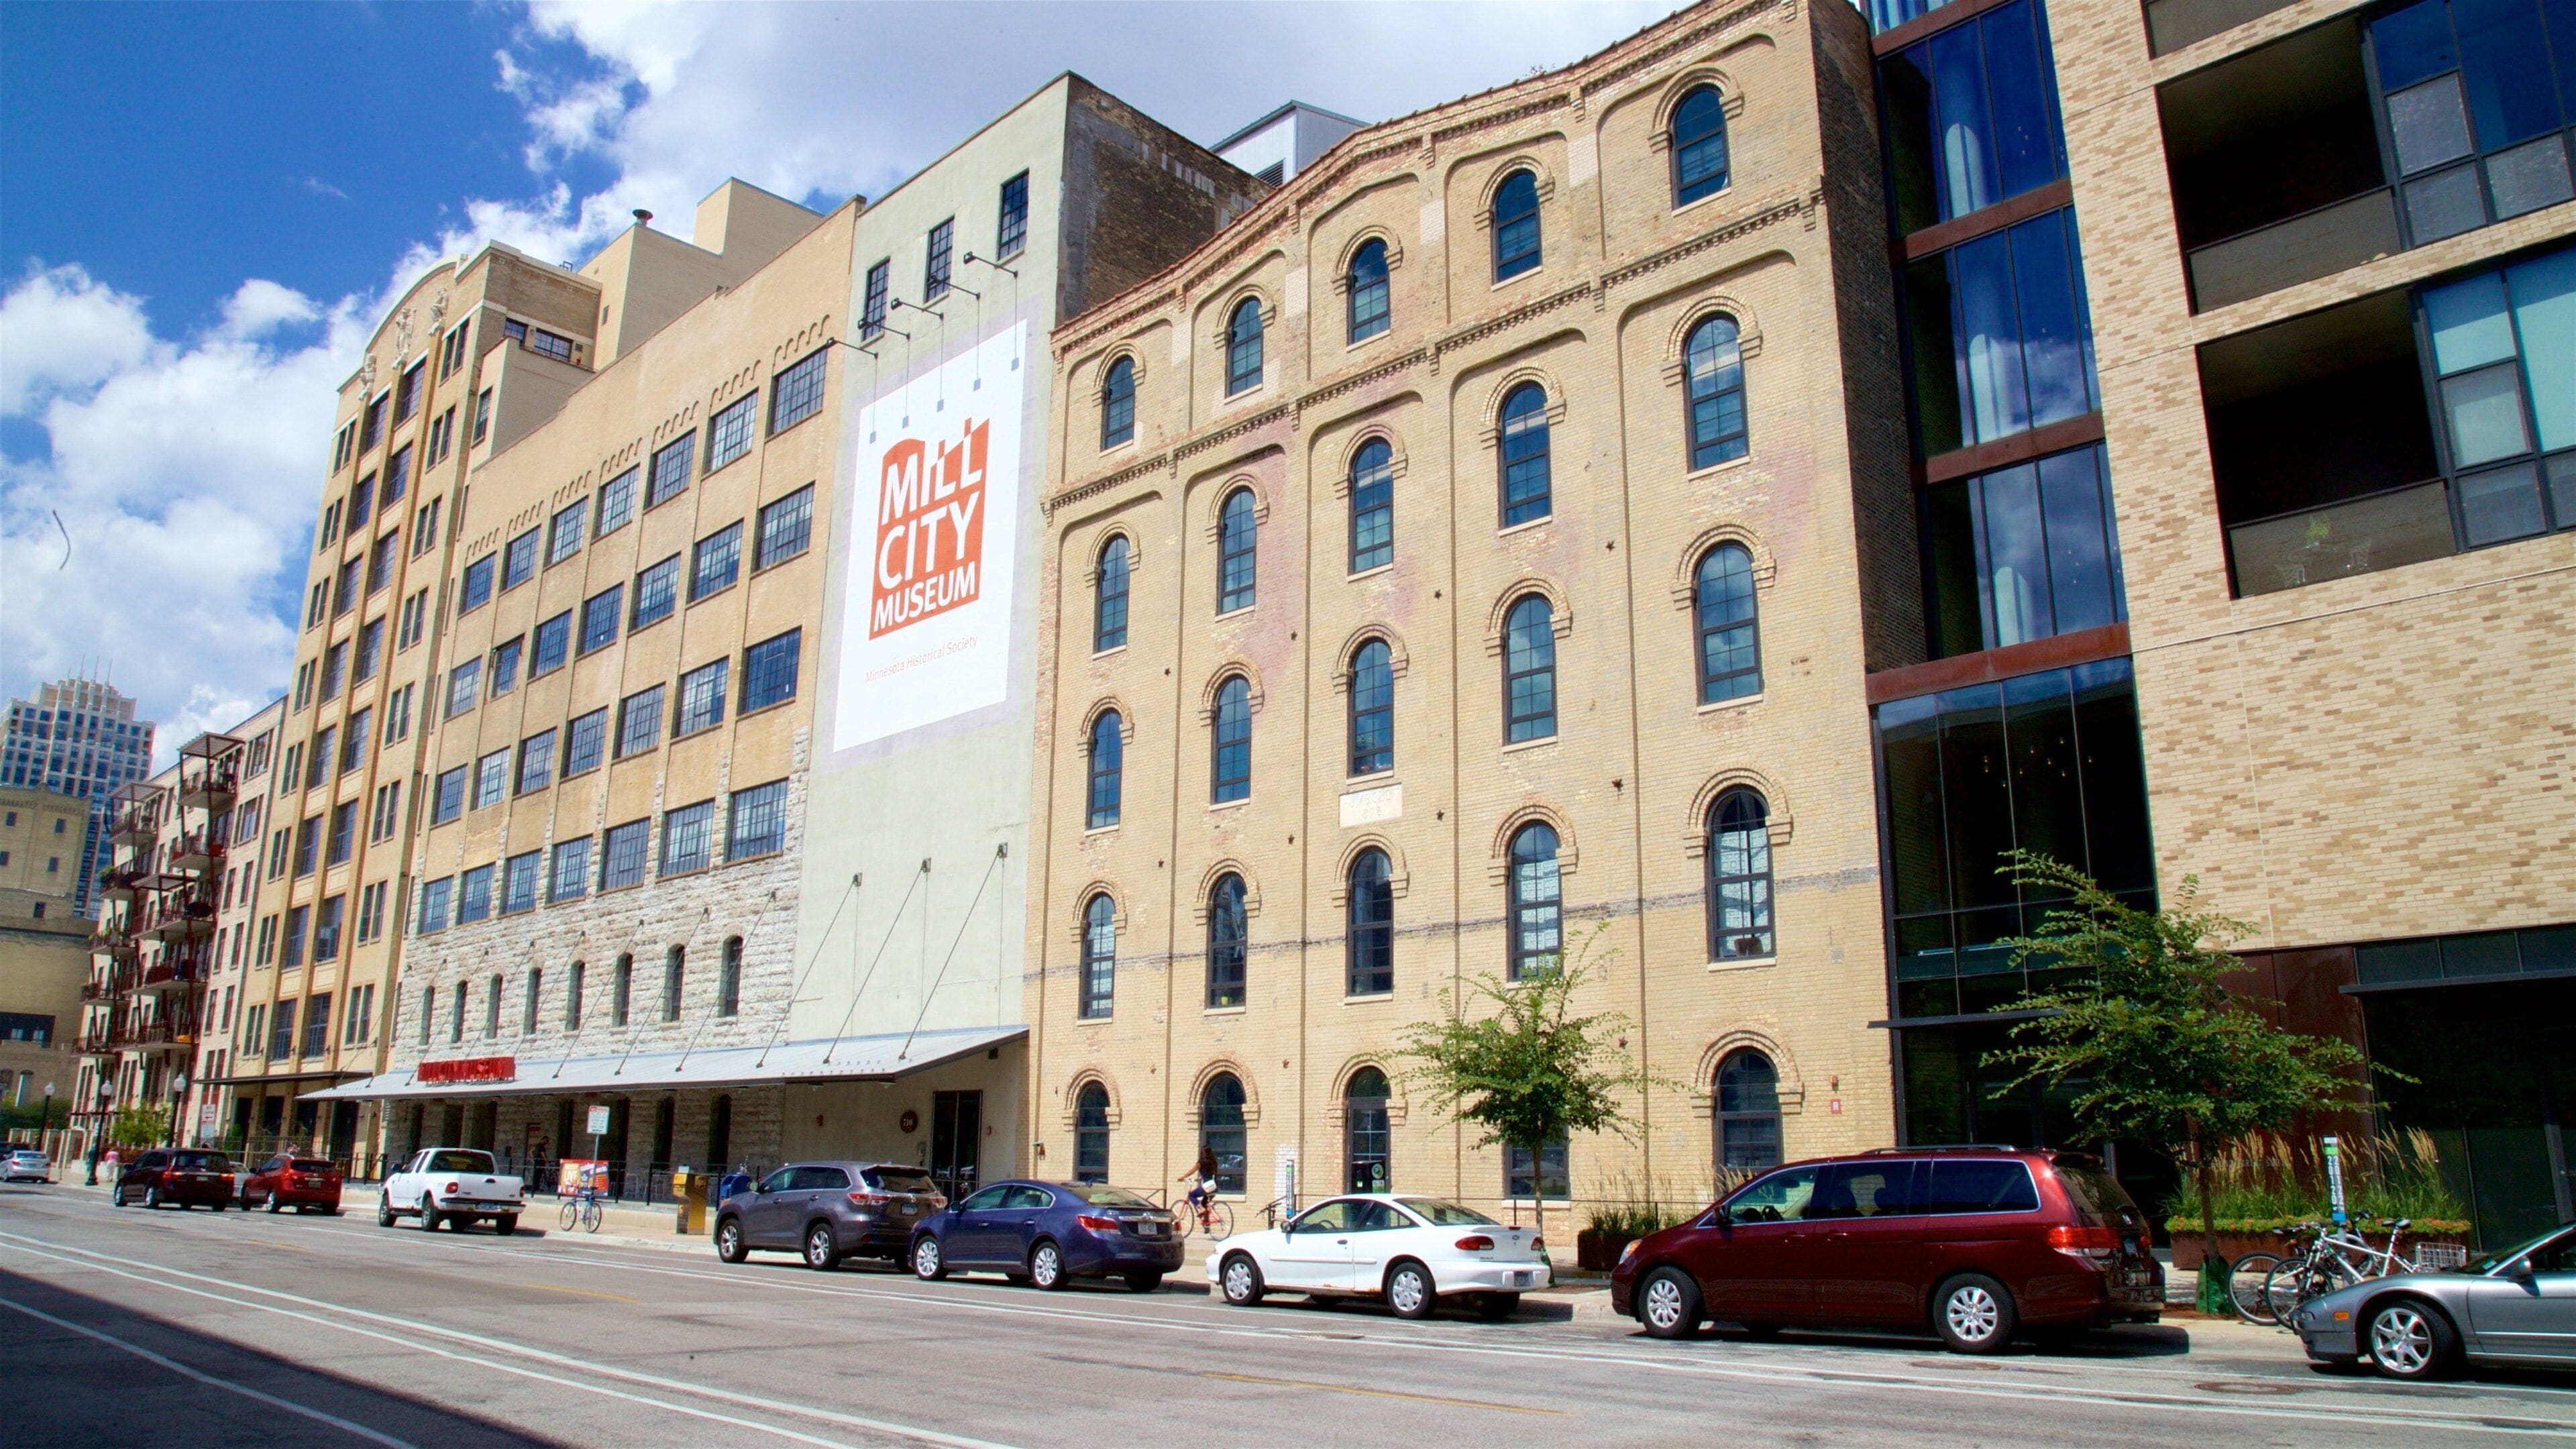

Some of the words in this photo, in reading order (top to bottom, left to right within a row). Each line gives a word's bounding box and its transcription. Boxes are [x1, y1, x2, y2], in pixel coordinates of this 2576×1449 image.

[881, 417, 983, 526] MILL
[879, 490, 979, 590] CITY
[873, 561, 975, 633] MUSEUM
[865, 661, 904, 684] Minnesota
[906, 644, 945, 668] Historical
[947, 635, 978, 655] Society
